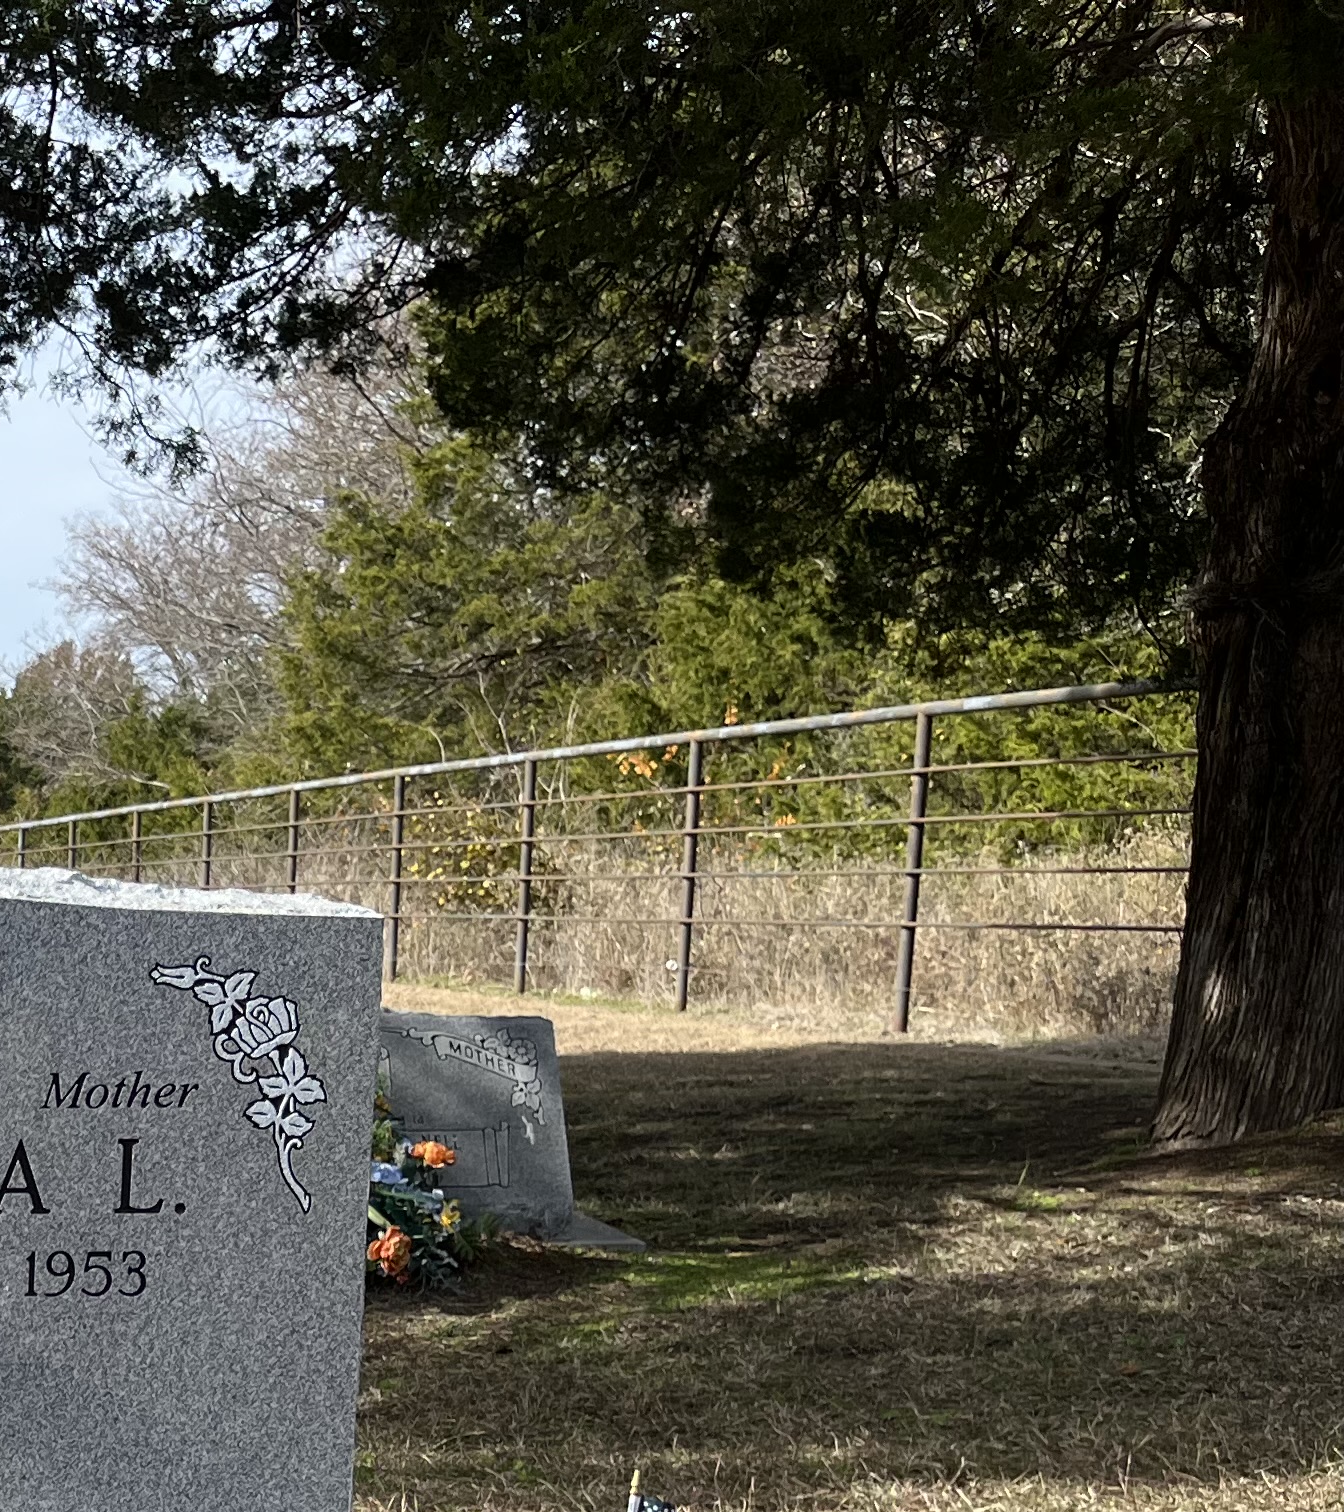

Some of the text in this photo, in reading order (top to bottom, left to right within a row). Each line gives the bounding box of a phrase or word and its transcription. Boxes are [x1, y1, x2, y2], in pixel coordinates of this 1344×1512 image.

[448, 1039, 517, 1077] MOTHER
[41, 1070, 199, 1110] Mother
[113, 1137, 187, 1215] L.
[24, 1250, 148, 1298] 1953
